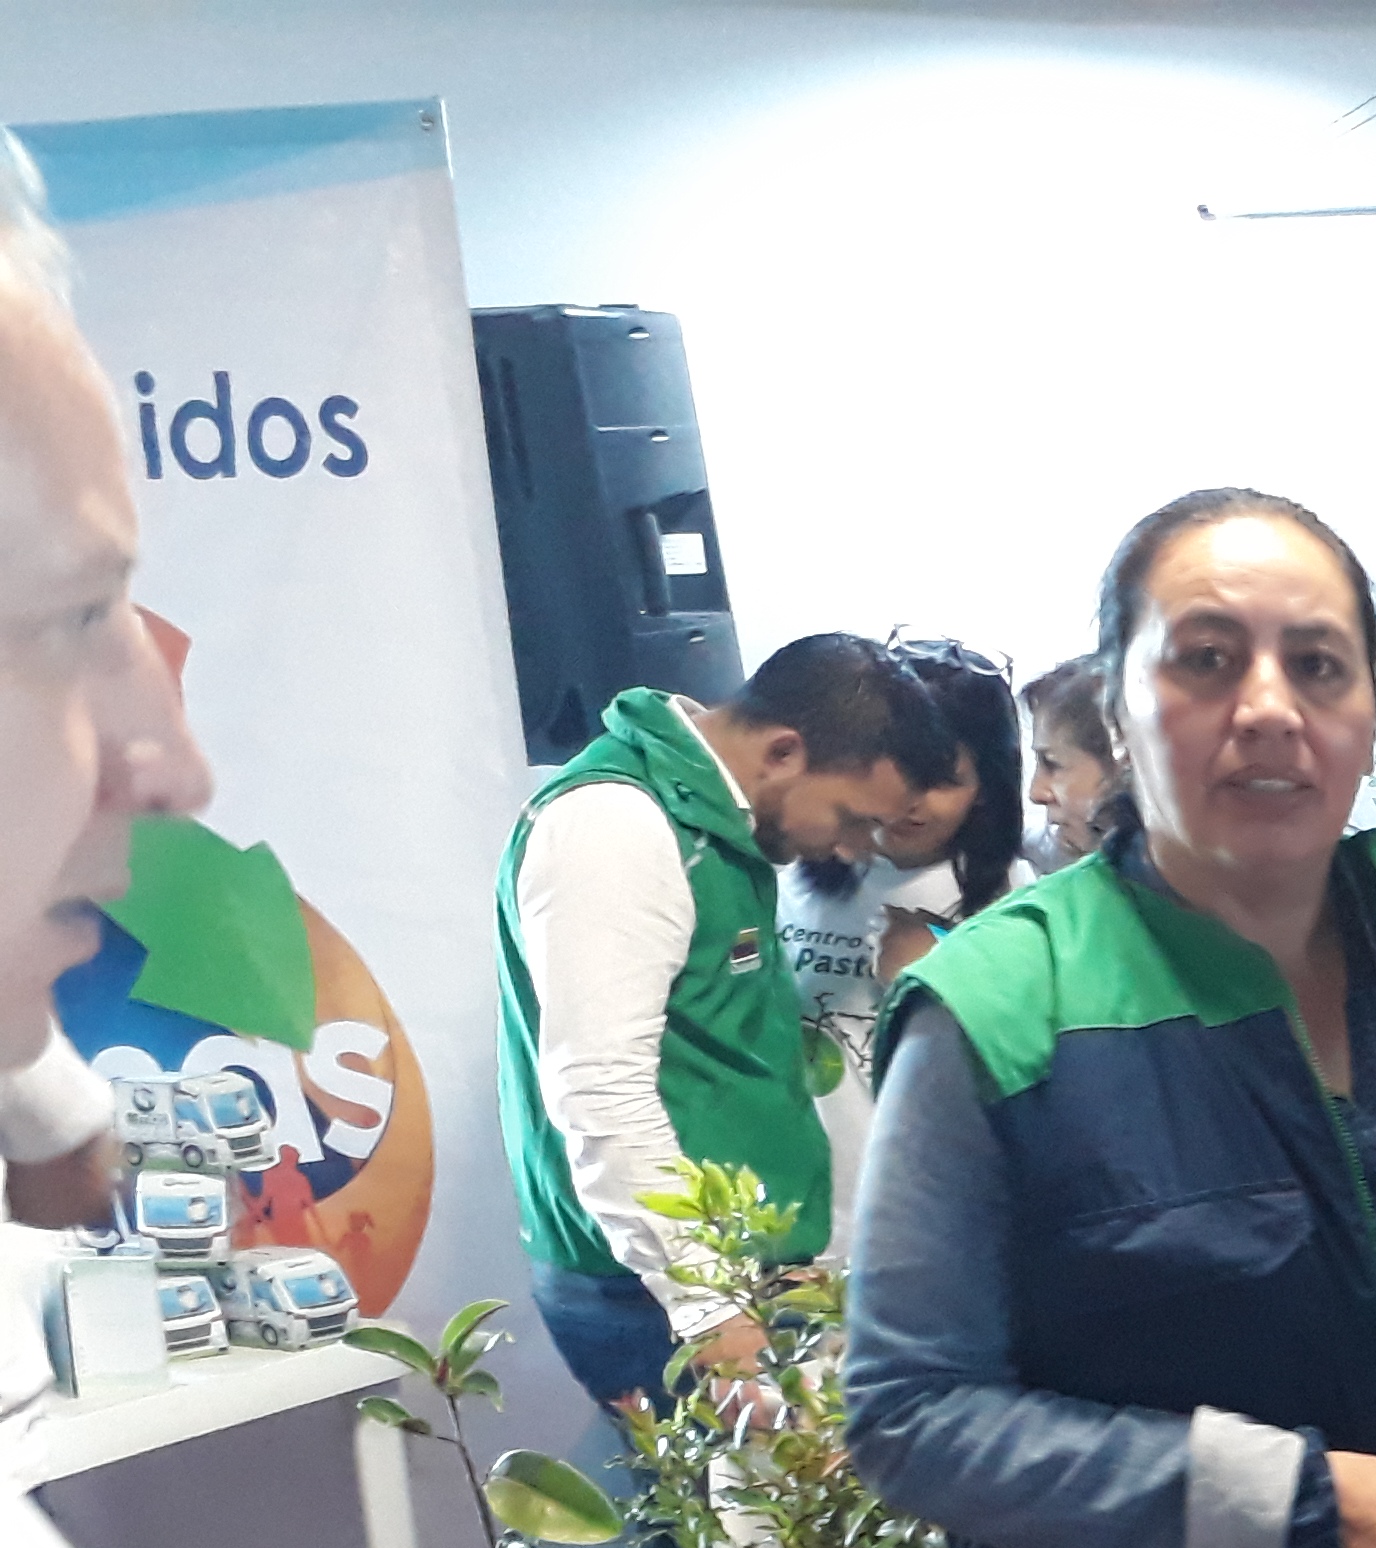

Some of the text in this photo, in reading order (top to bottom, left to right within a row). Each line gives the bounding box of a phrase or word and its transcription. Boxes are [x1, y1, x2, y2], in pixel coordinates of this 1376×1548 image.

[134, 369, 369, 480] idos
[781, 923, 862, 949] Centro
[795, 947, 876, 979] Past
